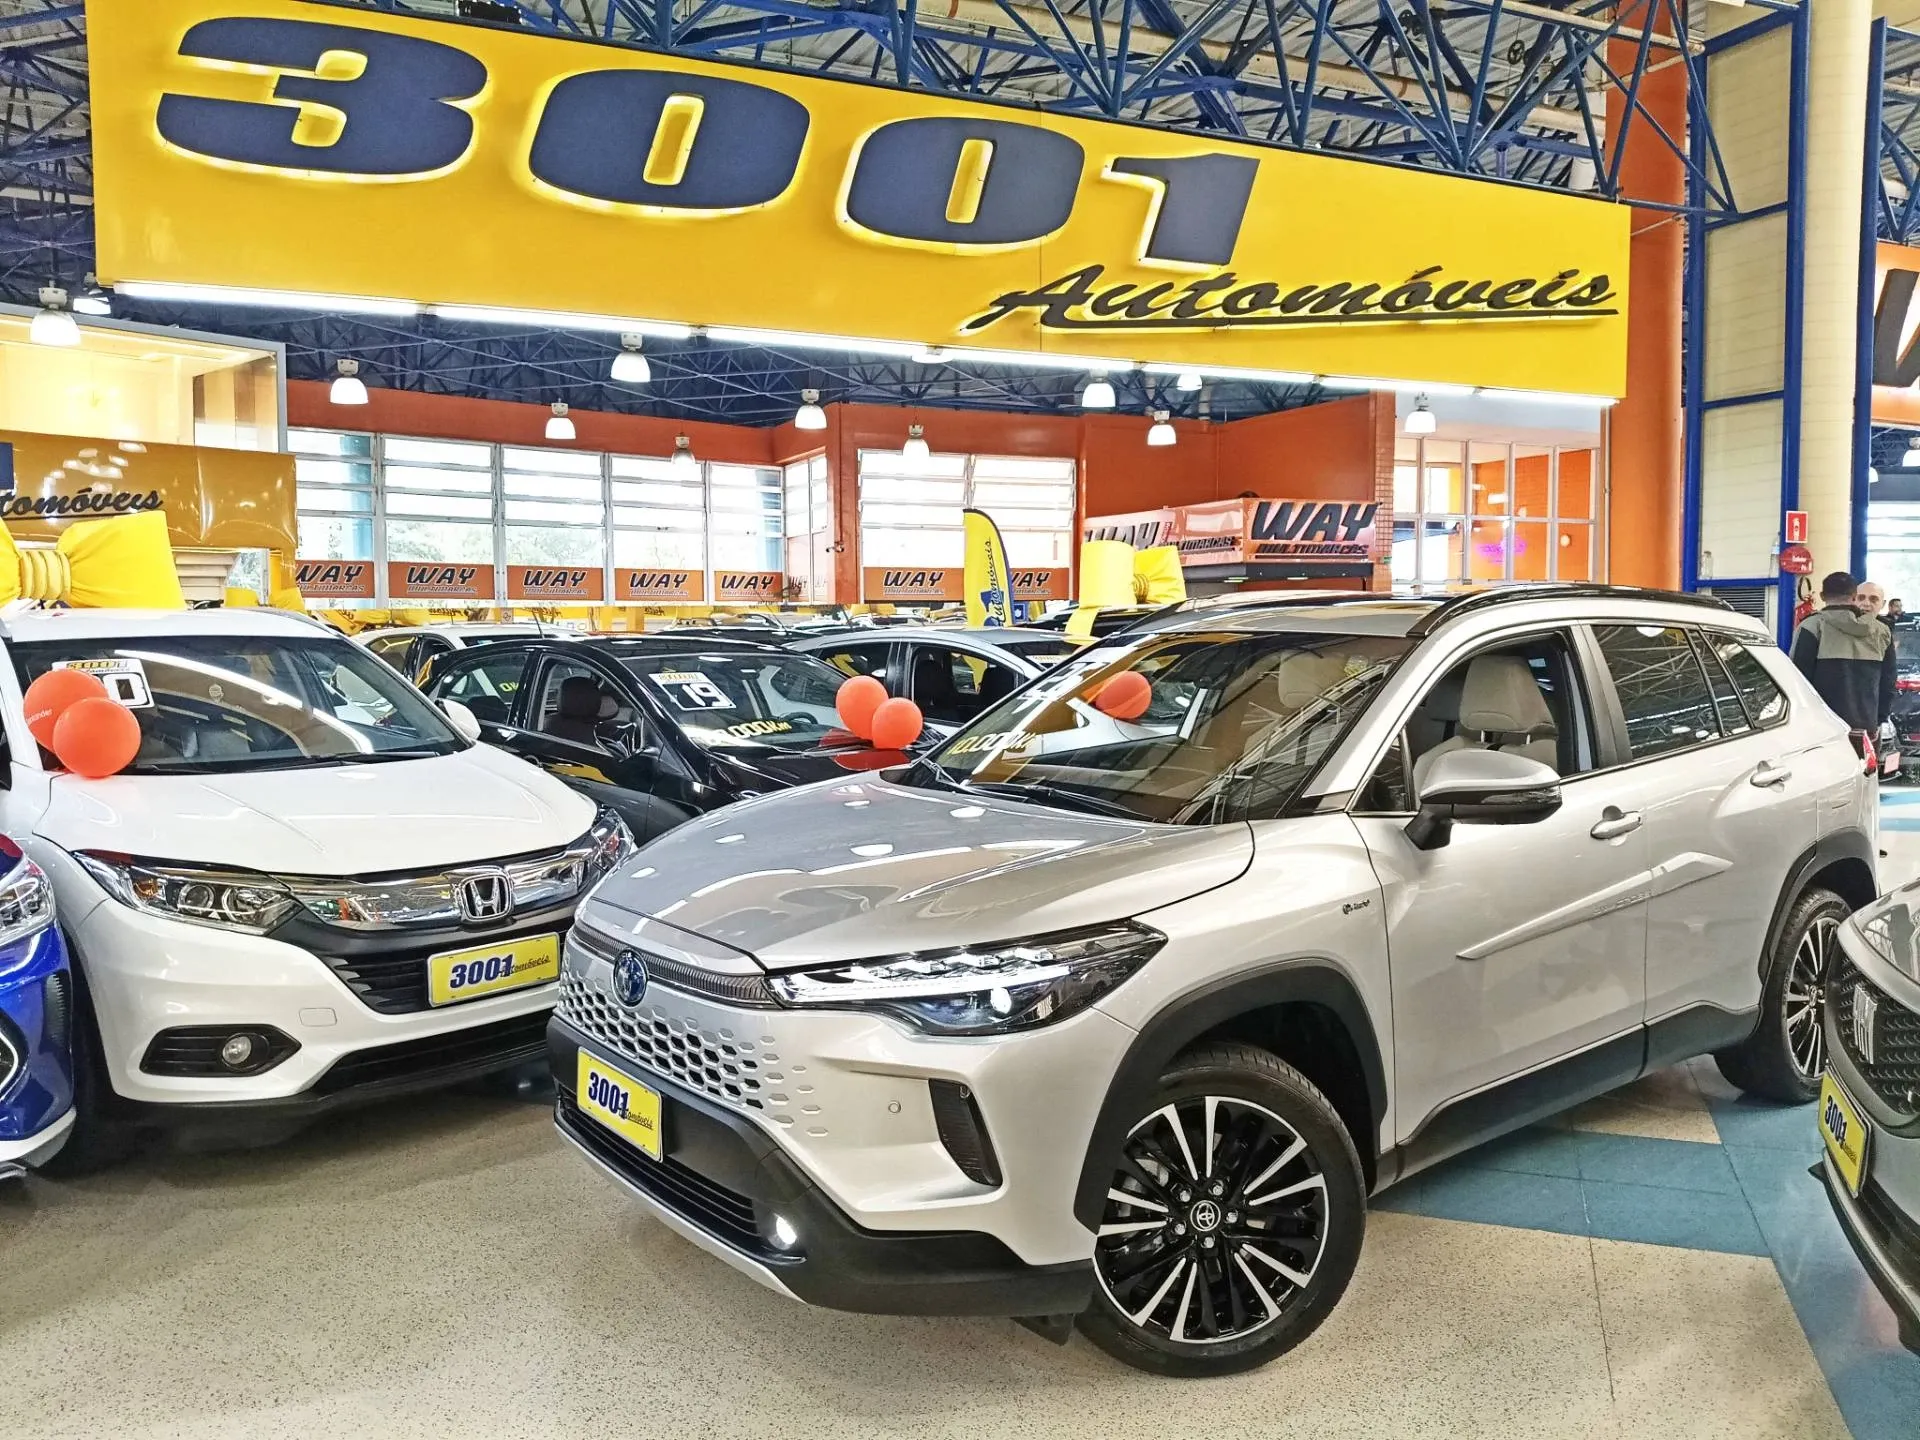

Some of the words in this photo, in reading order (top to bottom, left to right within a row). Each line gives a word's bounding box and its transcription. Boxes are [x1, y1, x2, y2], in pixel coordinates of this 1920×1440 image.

[156, 17, 1260, 265] 3001
[961, 263, 1619, 330] Automóveis
[0, 487, 164, 518] tomóveis
[1252, 501, 1380, 541] WAY
[406, 566, 477, 585] WAY
[523, 569, 588, 587] WAY
[629, 572, 688, 588] WAY
[720, 574, 775, 590] WAY
[884, 570, 944, 587] WAY
[102, 673, 150, 706] 0
[682, 683, 730, 707] 19
[450, 954, 513, 988] 3001
[588, 1071, 629, 1119] 3001
[1825, 1094, 1848, 1144] 3001
